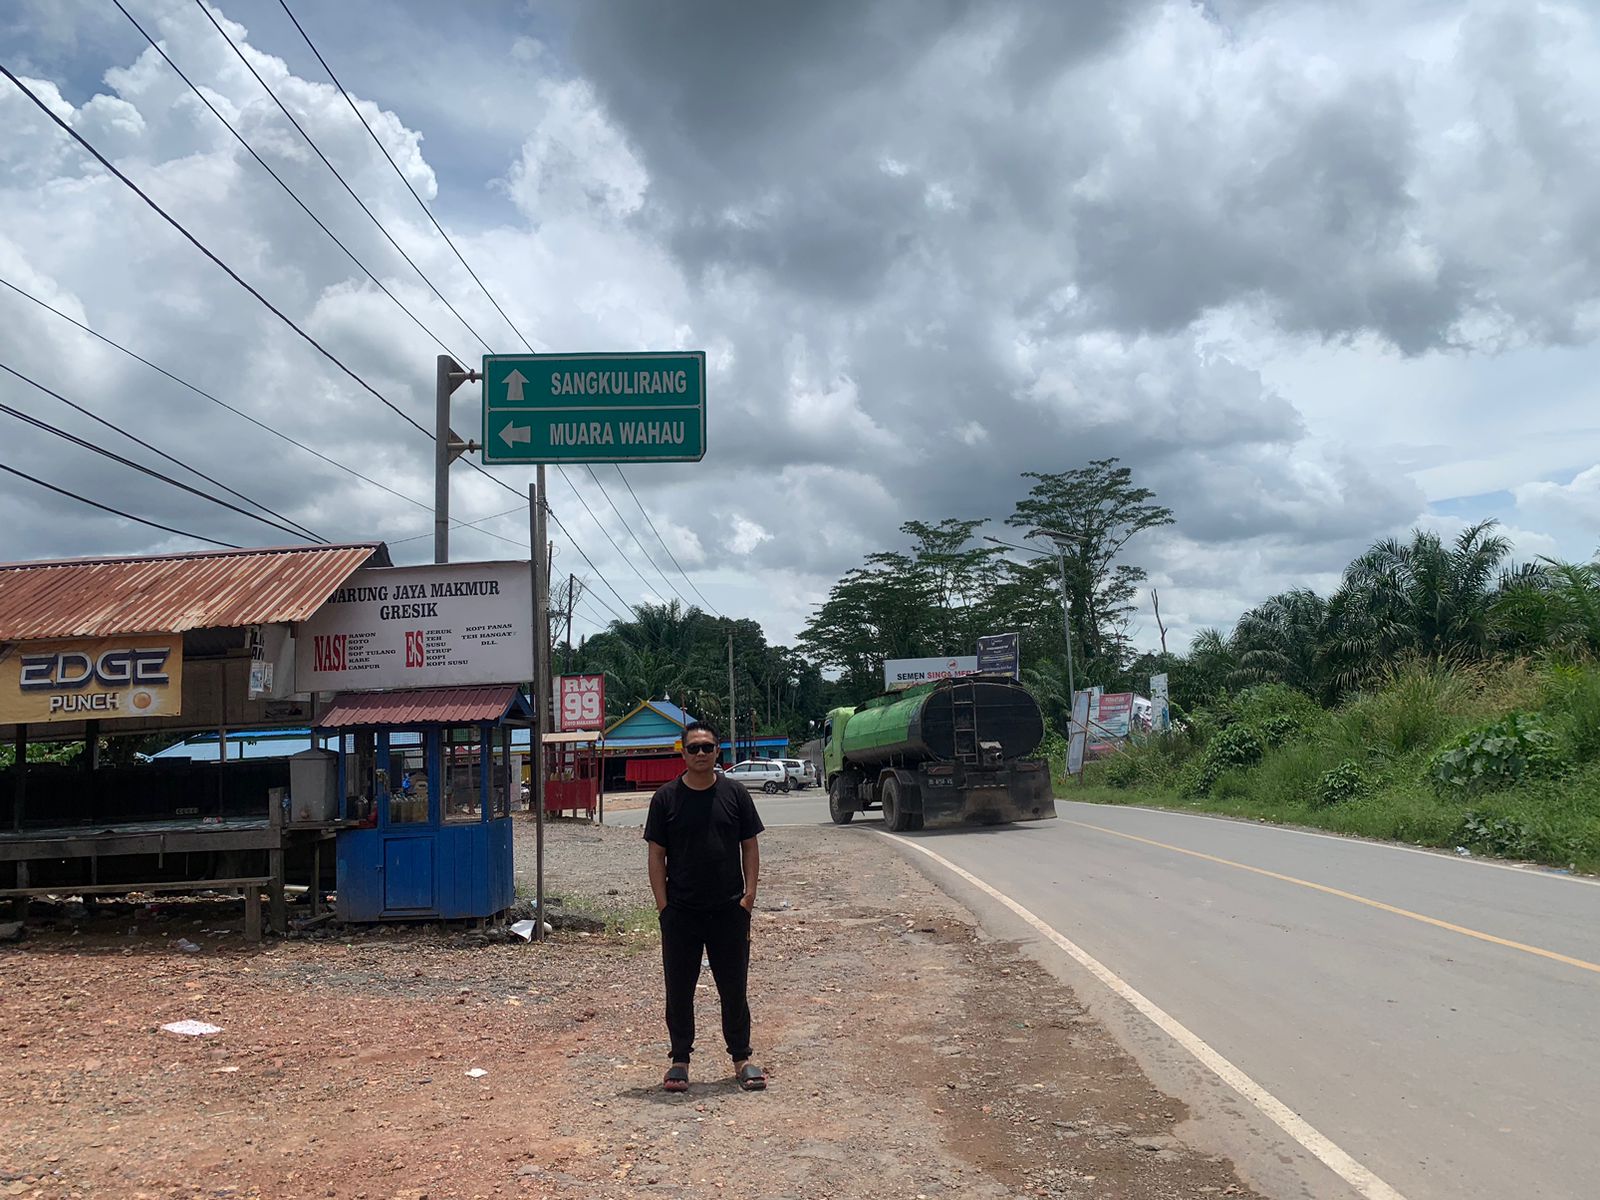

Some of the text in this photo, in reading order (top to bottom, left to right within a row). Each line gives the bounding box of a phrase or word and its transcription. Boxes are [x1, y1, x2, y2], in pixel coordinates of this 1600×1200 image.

[551, 370, 687, 395] SANGKULIRANG
[549, 421, 685, 446] MUARA WAHAU
[393, 584, 427, 600] JAYA
[430, 580, 500, 598] MAKMUR
[380, 602, 438, 620] GRESIK
[314, 634, 347, 672] NASI
[405, 630, 424, 668] ES
[19, 646, 171, 691] EDGE
[897, 672, 925, 681] SEMEN
[565, 678, 599, 692] RM
[49, 692, 121, 713] PUNCH
[565, 692, 599, 720] 99
